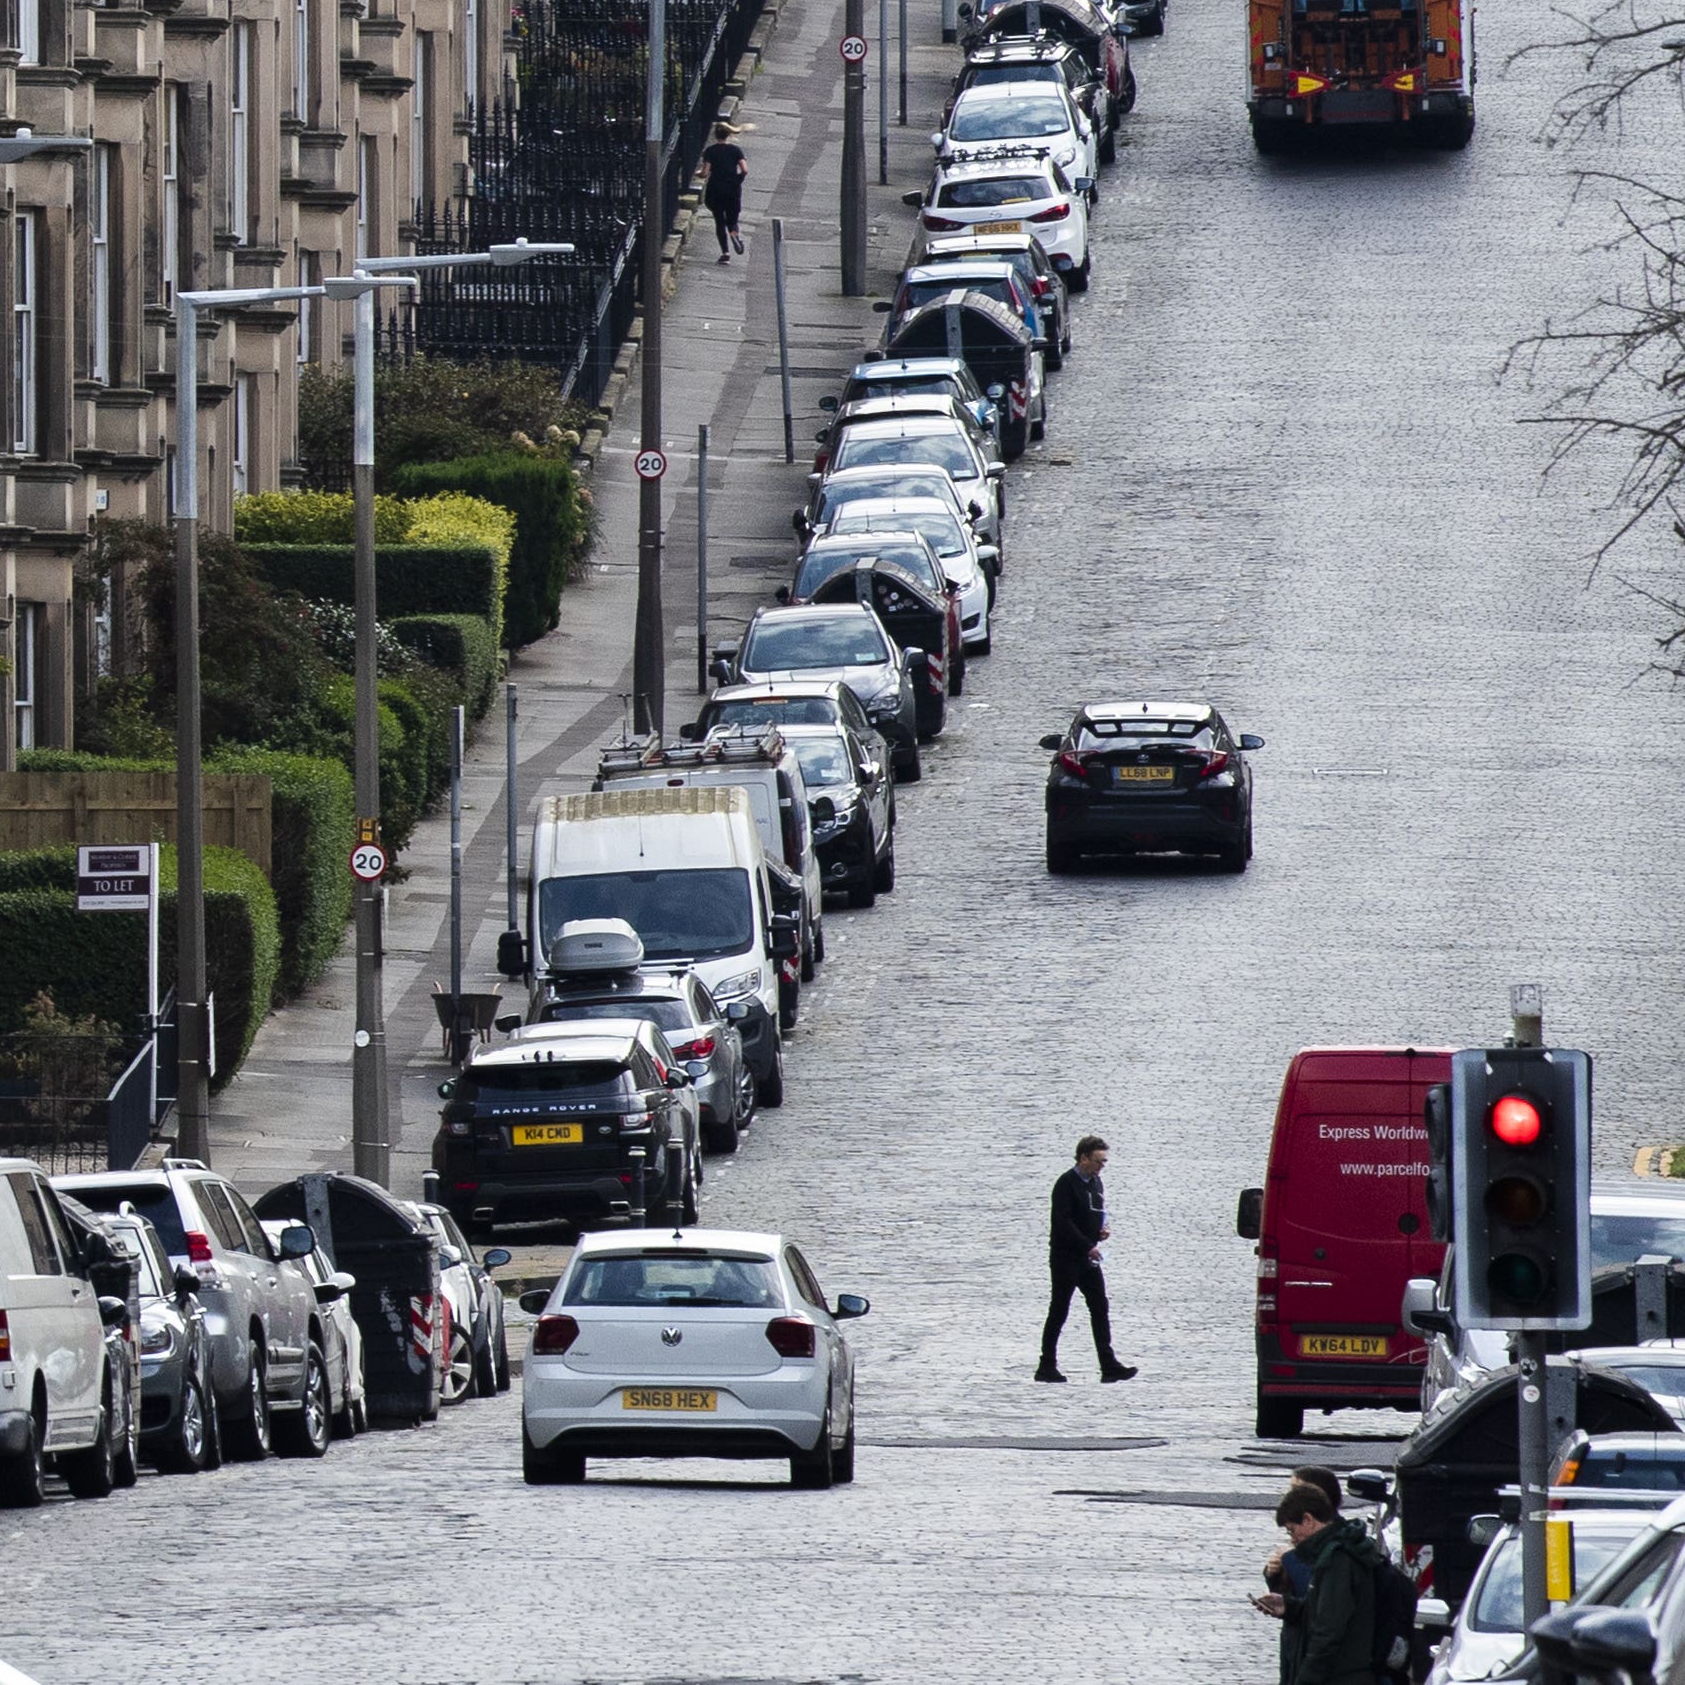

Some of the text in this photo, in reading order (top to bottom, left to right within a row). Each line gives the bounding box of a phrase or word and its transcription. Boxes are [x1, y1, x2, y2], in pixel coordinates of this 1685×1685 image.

[844, 42, 863, 54] 20
[640, 457, 662, 471] 20
[1120, 768, 1170, 778] LL68 LNP
[355, 853, 382, 871] 20
[93, 879, 135, 892] TO LET
[1319, 1124, 1371, 1142] Express
[1309, 1338, 1380, 1353] KW64 LDV
[630, 1391, 710, 1408] SN68 HEX
